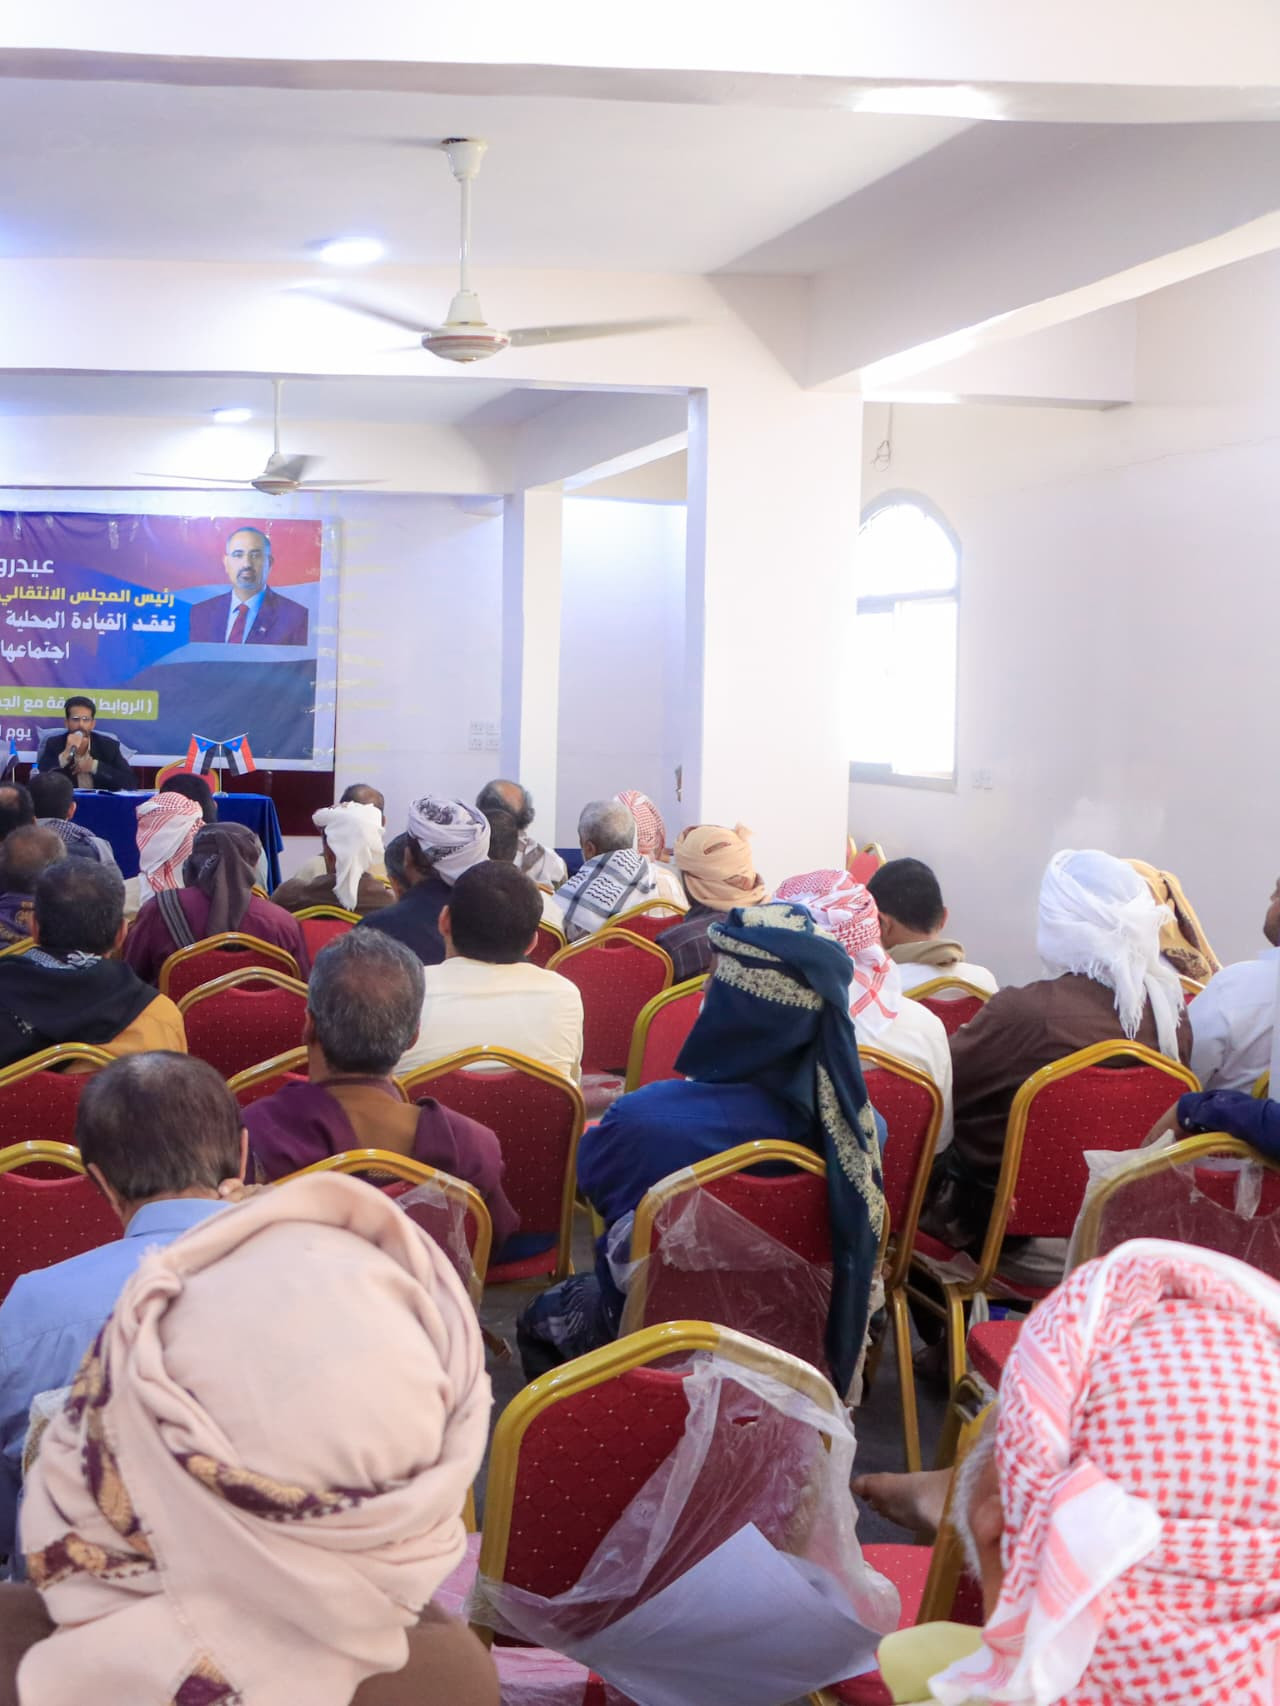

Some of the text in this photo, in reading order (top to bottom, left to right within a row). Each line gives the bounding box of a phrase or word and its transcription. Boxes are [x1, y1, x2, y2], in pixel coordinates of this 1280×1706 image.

[70, 588, 130, 605] المجلس
[134, 587, 175, 608] رئيس
[6, 609, 65, 632] المحلية
[71, 611, 126, 635] القيادة
[132, 613, 176, 633] تعقد
[1, 640, 69, 663] اجتماعها
[23, 698, 44, 713] مع
[99, 697, 144, 715] الروابط
[6, 728, 32, 741] يوم
